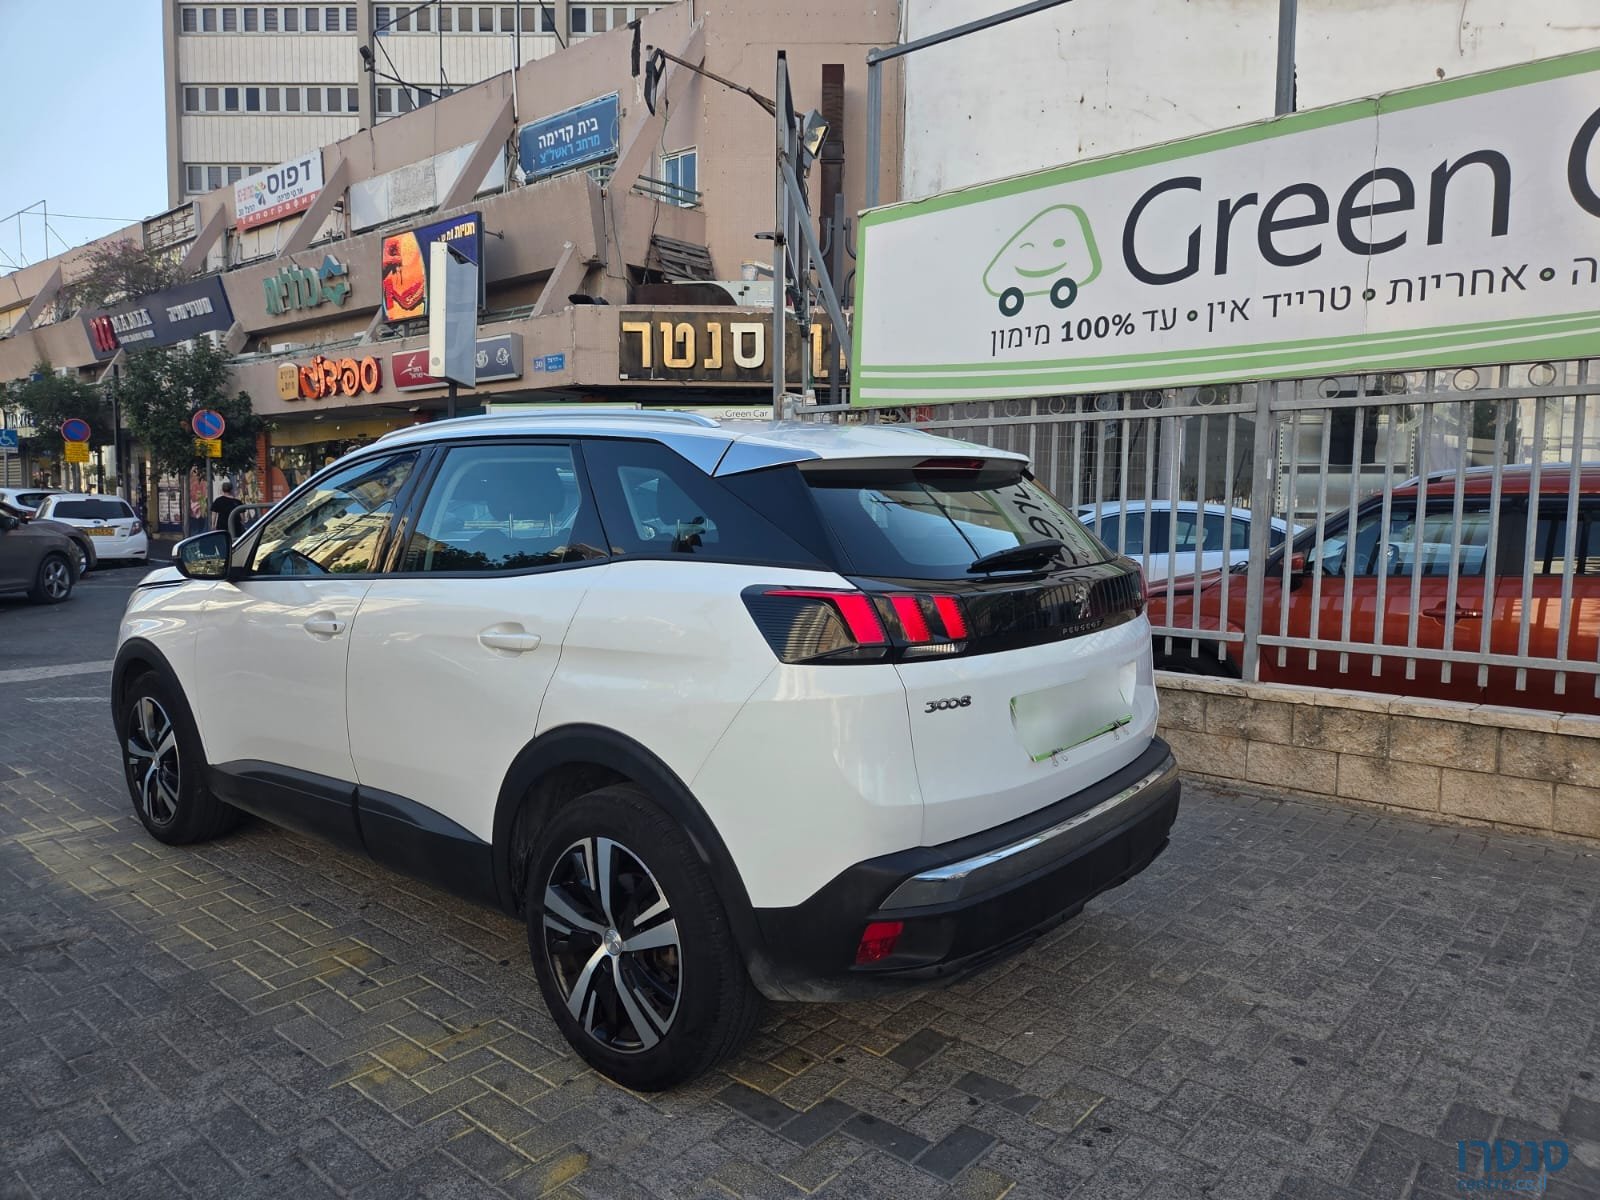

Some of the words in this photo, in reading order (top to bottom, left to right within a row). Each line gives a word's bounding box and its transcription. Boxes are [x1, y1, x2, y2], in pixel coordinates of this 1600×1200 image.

[538, 125, 573, 149] קדימה
[577, 117, 599, 136] בית
[576, 134, 600, 151] מרחב
[267, 160, 311, 194] דפוס
[1122, 149, 1512, 286] Green
[1386, 264, 1528, 305] אחריות
[1207, 298, 1250, 333] אין
[1263, 285, 1352, 318] טרייד
[1060, 313, 1136, 342] 100%
[1142, 307, 1177, 332] עד
[622, 321, 765, 369] סנטר
[990, 323, 1050, 357] מימון
[725, 409, 751, 418] Green
[752, 409, 768, 418] Car
[1062, 618, 1104, 635] PEUGEOT
[925, 695, 972, 713] 3008
